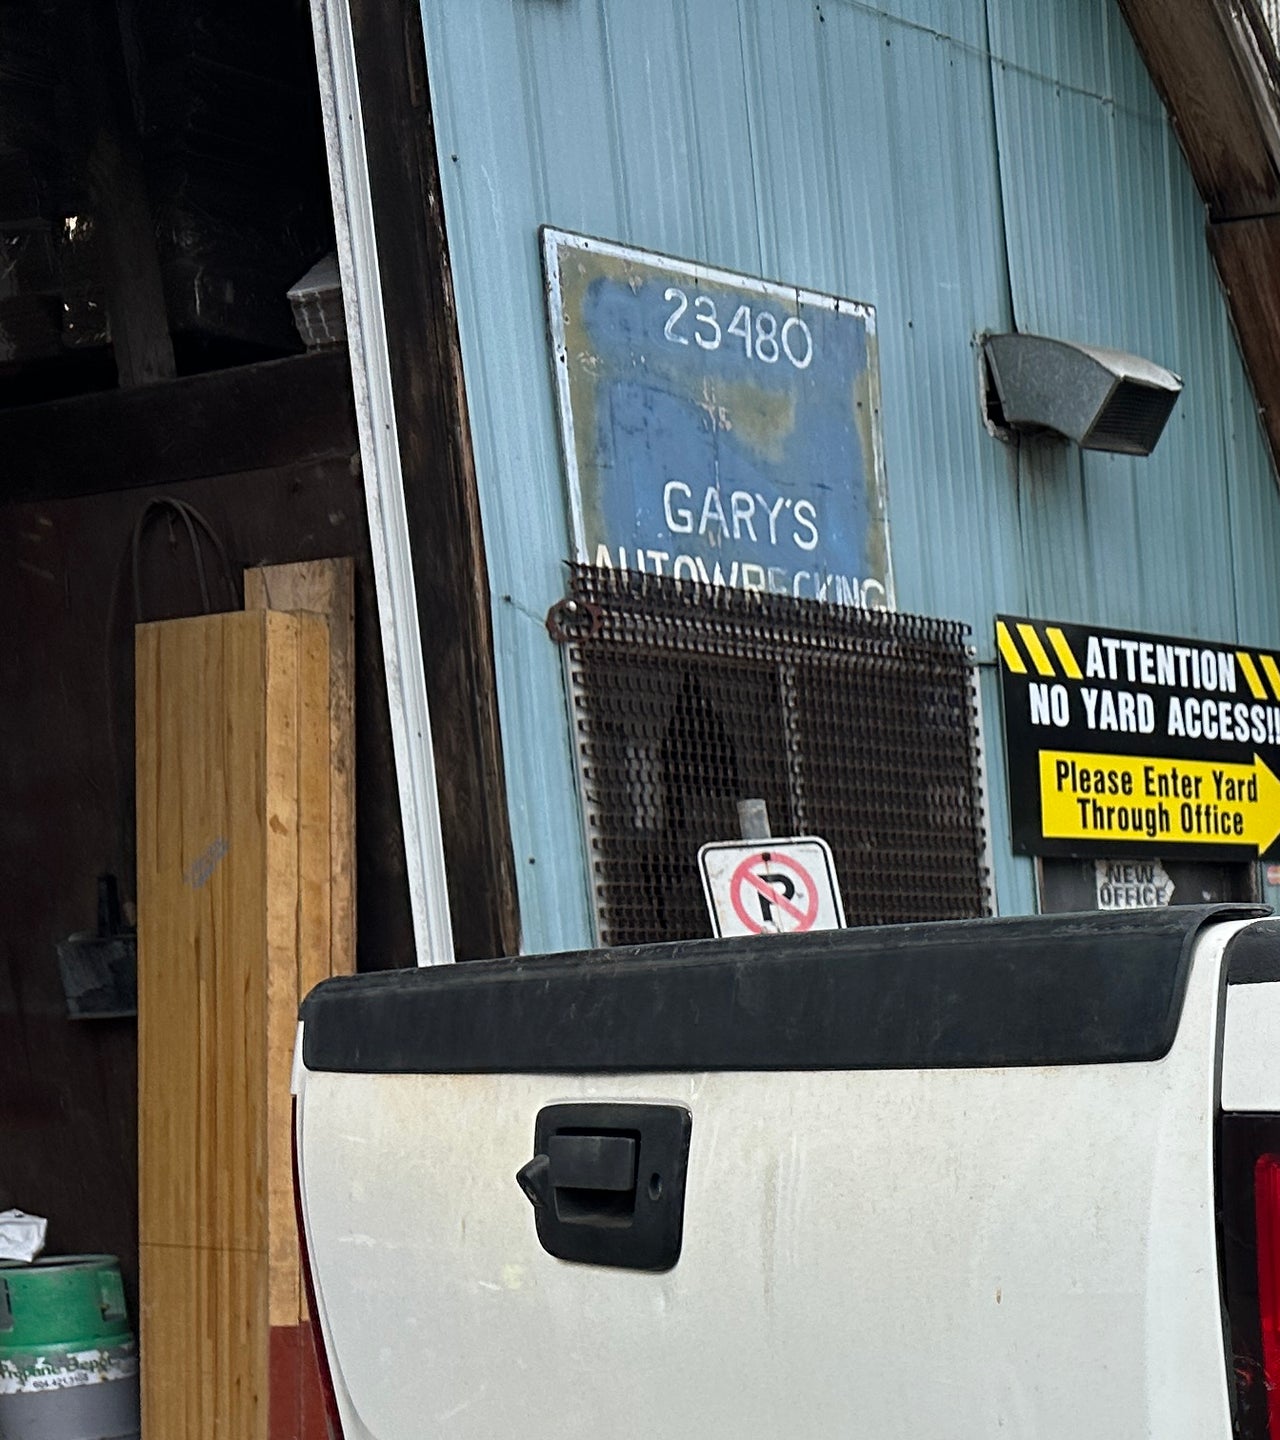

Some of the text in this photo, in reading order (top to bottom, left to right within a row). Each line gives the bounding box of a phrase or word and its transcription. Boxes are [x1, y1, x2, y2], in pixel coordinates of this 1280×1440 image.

[662, 287, 814, 370] 23480
[662, 480, 819, 551] GARY'S
[1086, 636, 1238, 694] ATTENTION
[1028, 682, 1070, 727] NO
[1080, 687, 1155, 734] YARD
[1055, 760, 1259, 803] Please Enter Yard
[1076, 798, 1245, 838] Through Office
[1099, 882, 1167, 908] OFFICE
[1106, 863, 1155, 885] NEW
